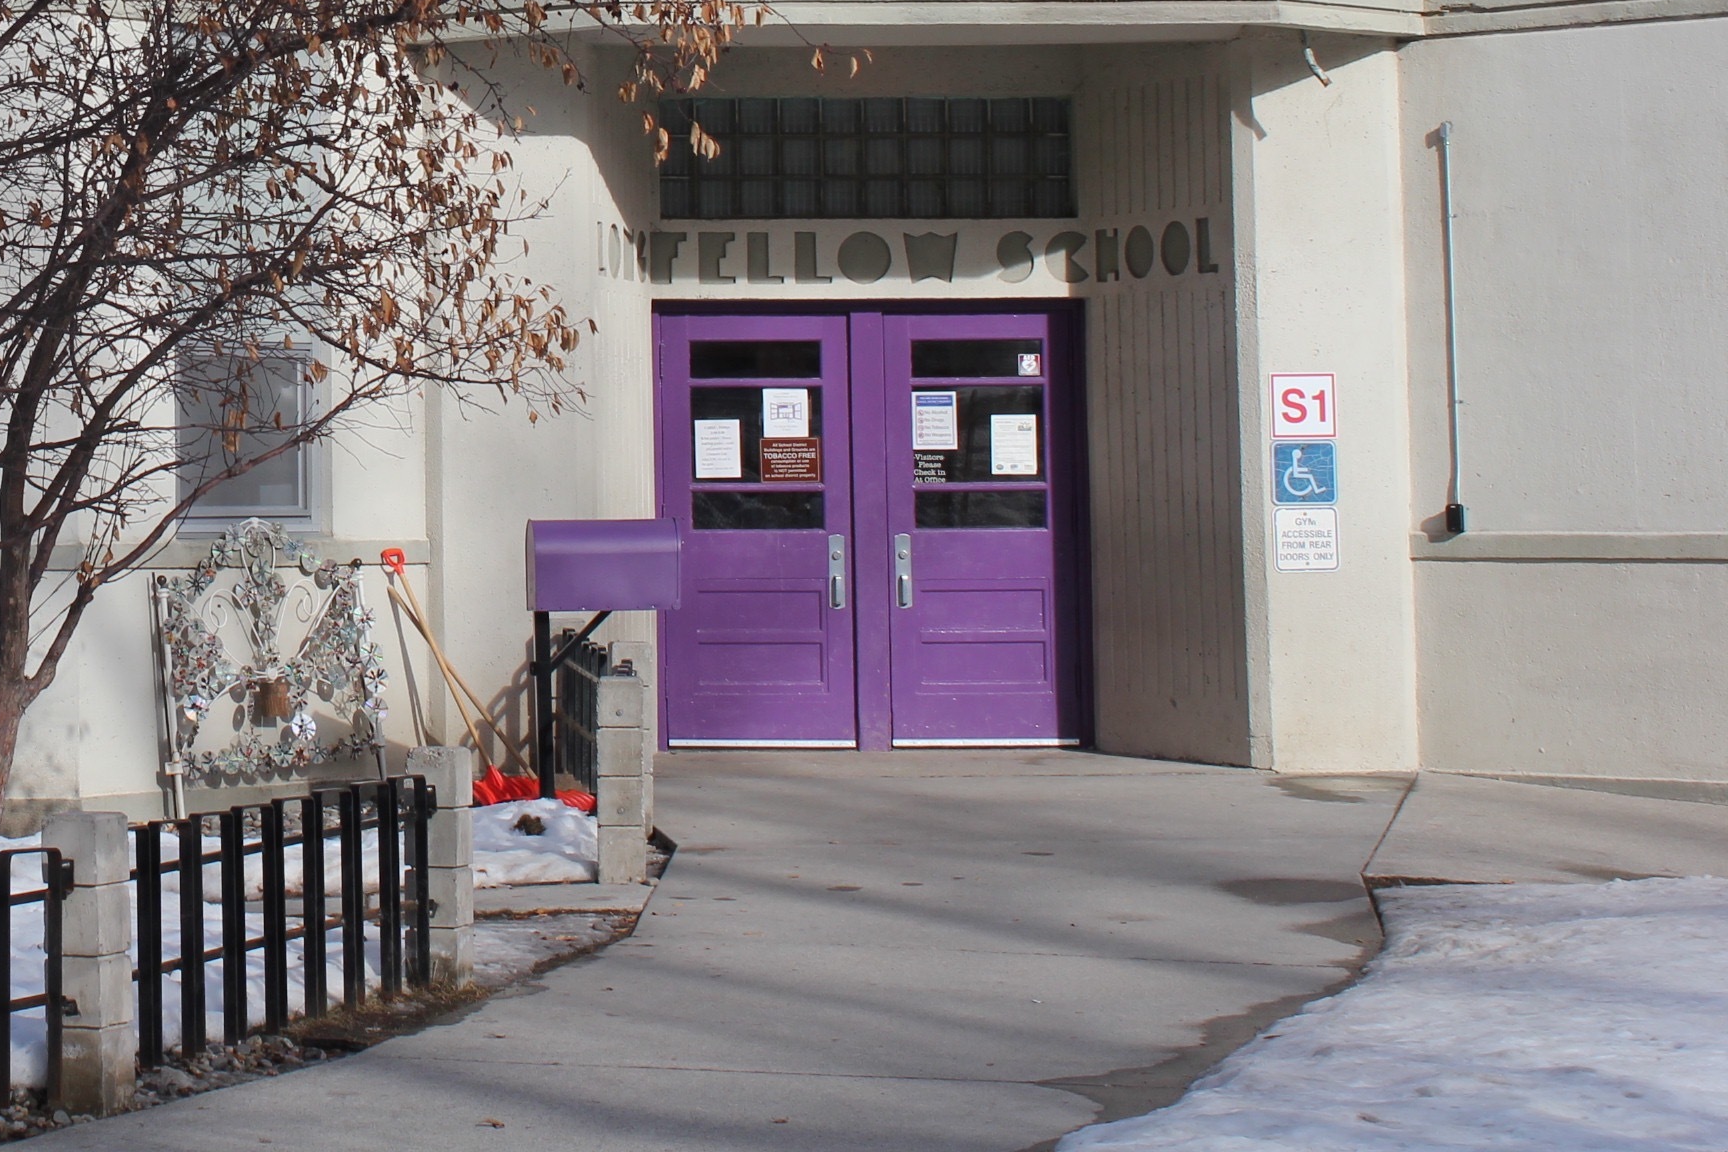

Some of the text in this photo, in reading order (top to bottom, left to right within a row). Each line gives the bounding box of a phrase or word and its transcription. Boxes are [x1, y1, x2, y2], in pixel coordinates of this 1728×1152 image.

[996, 217, 1219, 284] SCHOOL
[1281, 388, 1327, 424] S1
[1281, 529, 1332, 538] ACCESSIBLE
[1281, 540, 1332, 549] FROM REAR
[1279, 552, 1334, 561] DOORS ONLY
